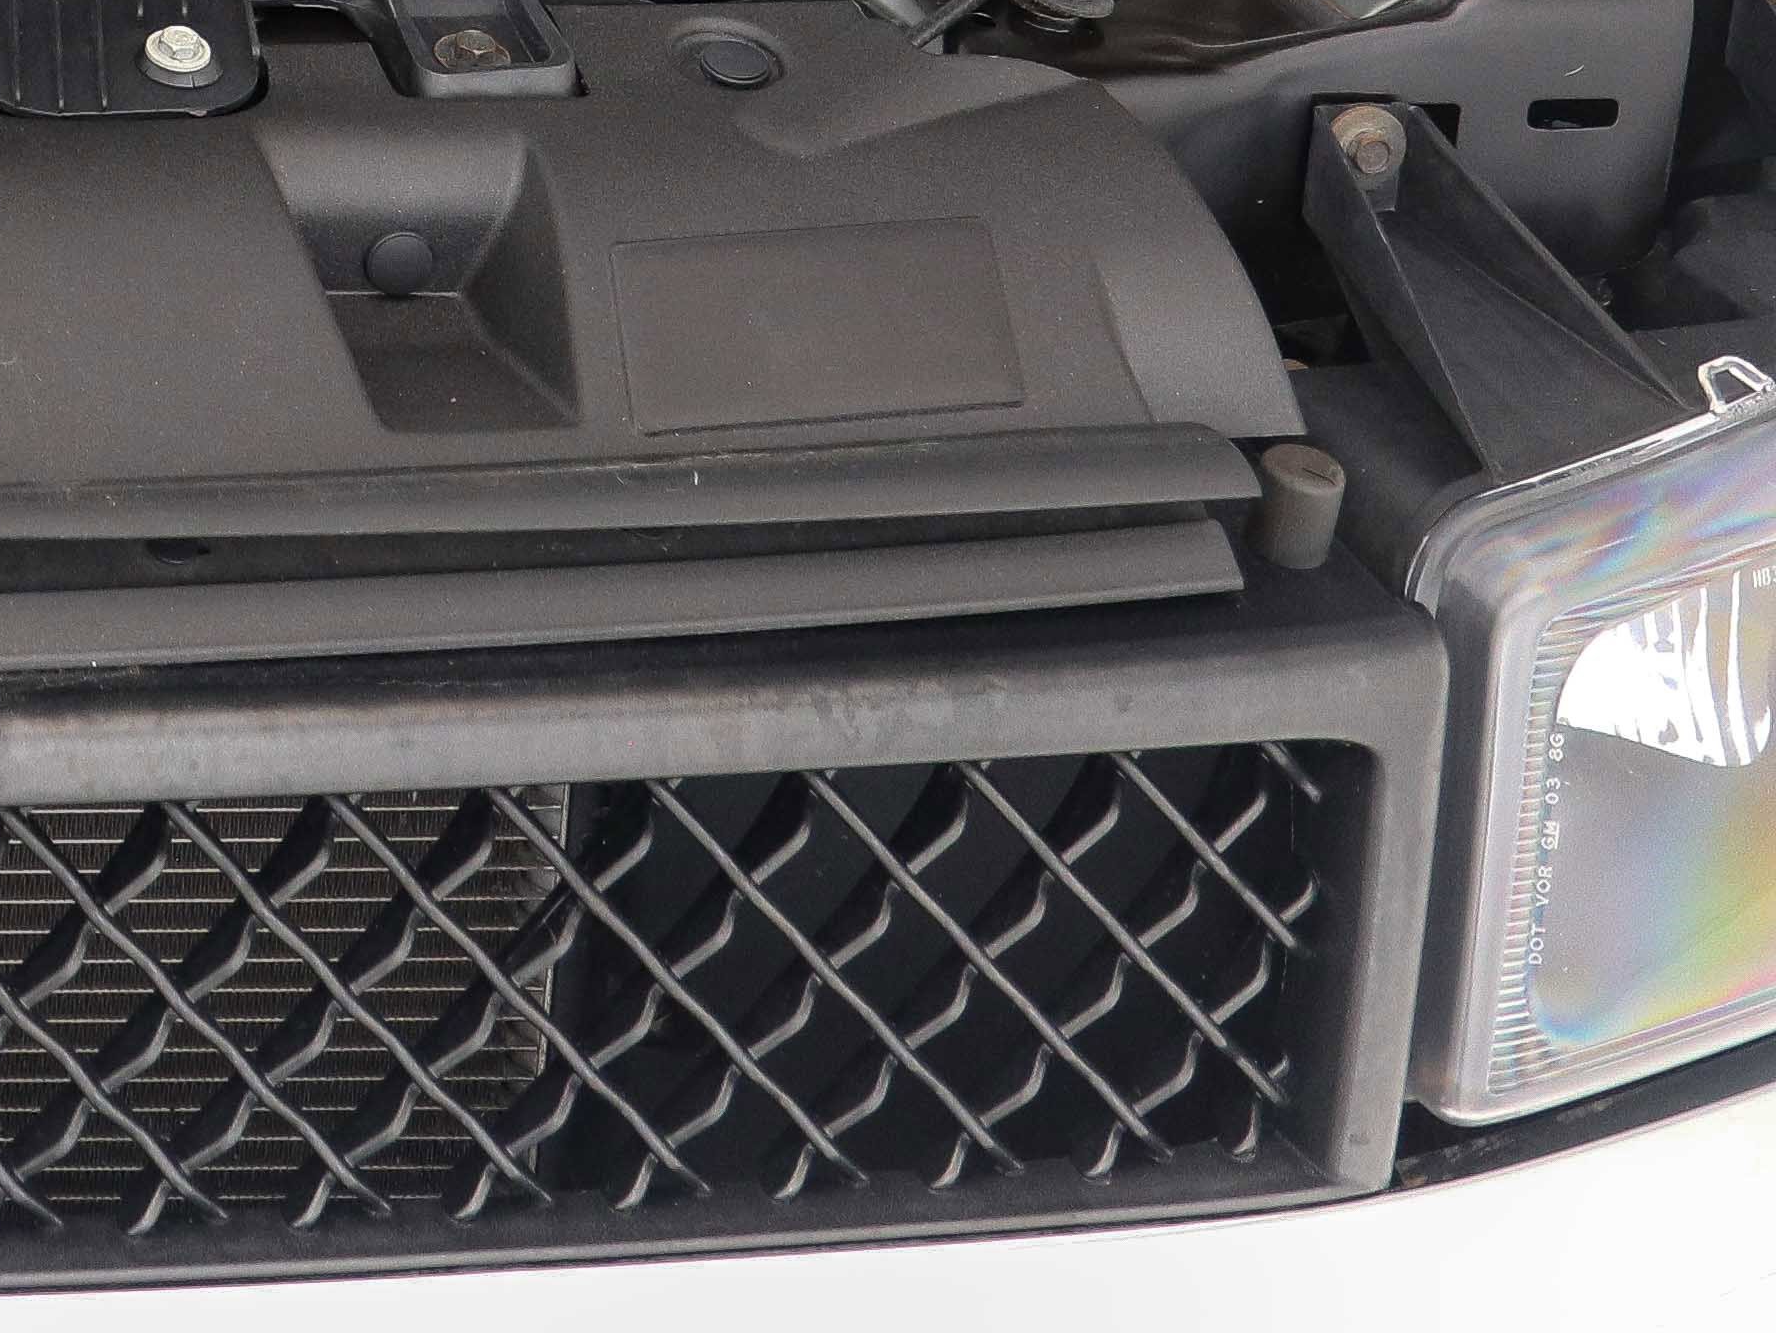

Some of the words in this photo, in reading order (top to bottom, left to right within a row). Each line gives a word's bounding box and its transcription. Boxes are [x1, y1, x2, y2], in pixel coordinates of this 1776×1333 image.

[1544, 777, 1561, 805] 03
[1541, 821, 1560, 850] GM
[1535, 866, 1553, 907] VOR
[1528, 924, 1547, 966] DOT
